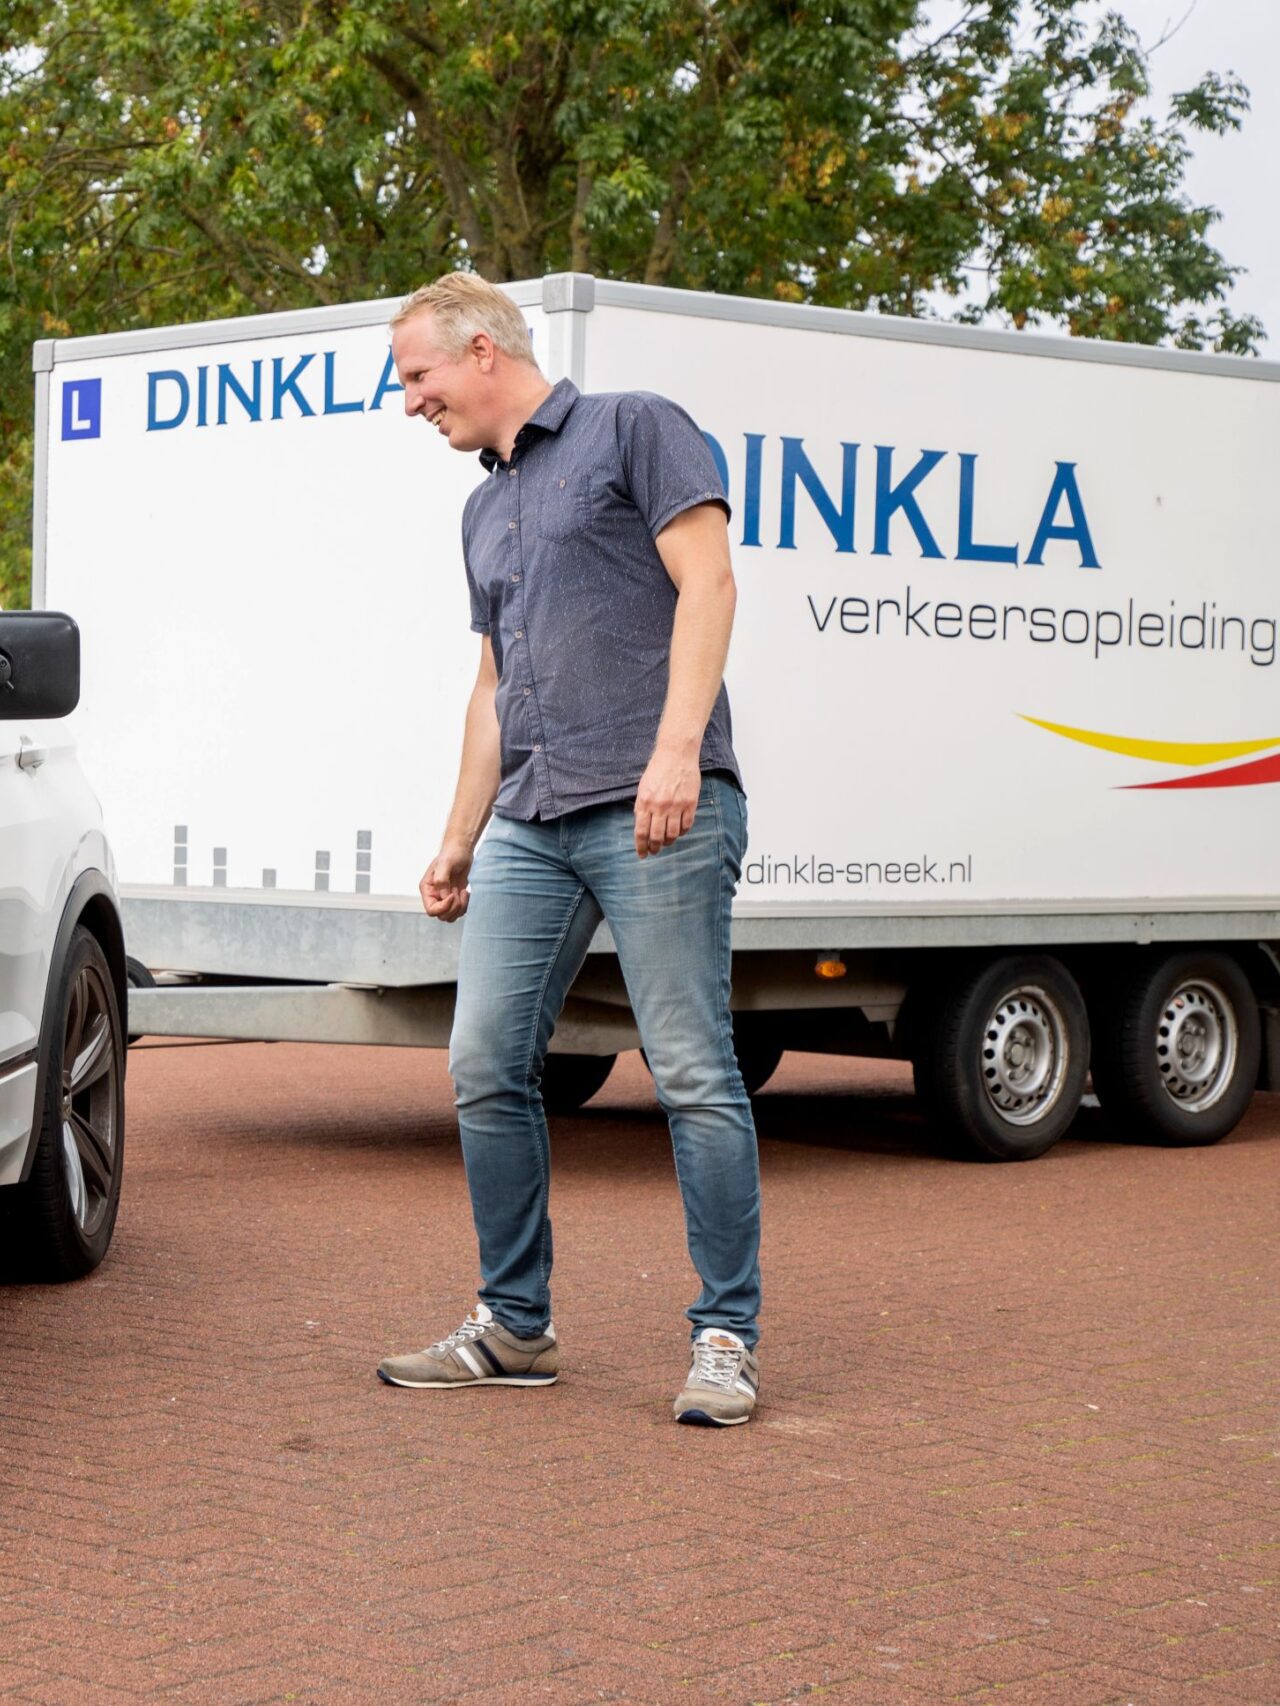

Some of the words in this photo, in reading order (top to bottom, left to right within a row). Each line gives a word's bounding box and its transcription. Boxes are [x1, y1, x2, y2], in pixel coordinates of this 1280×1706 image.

[71, 390, 91, 430] L
[700, 430, 1102, 569] INKLA
[807, 585, 1276, 667] verkeersopleiding
